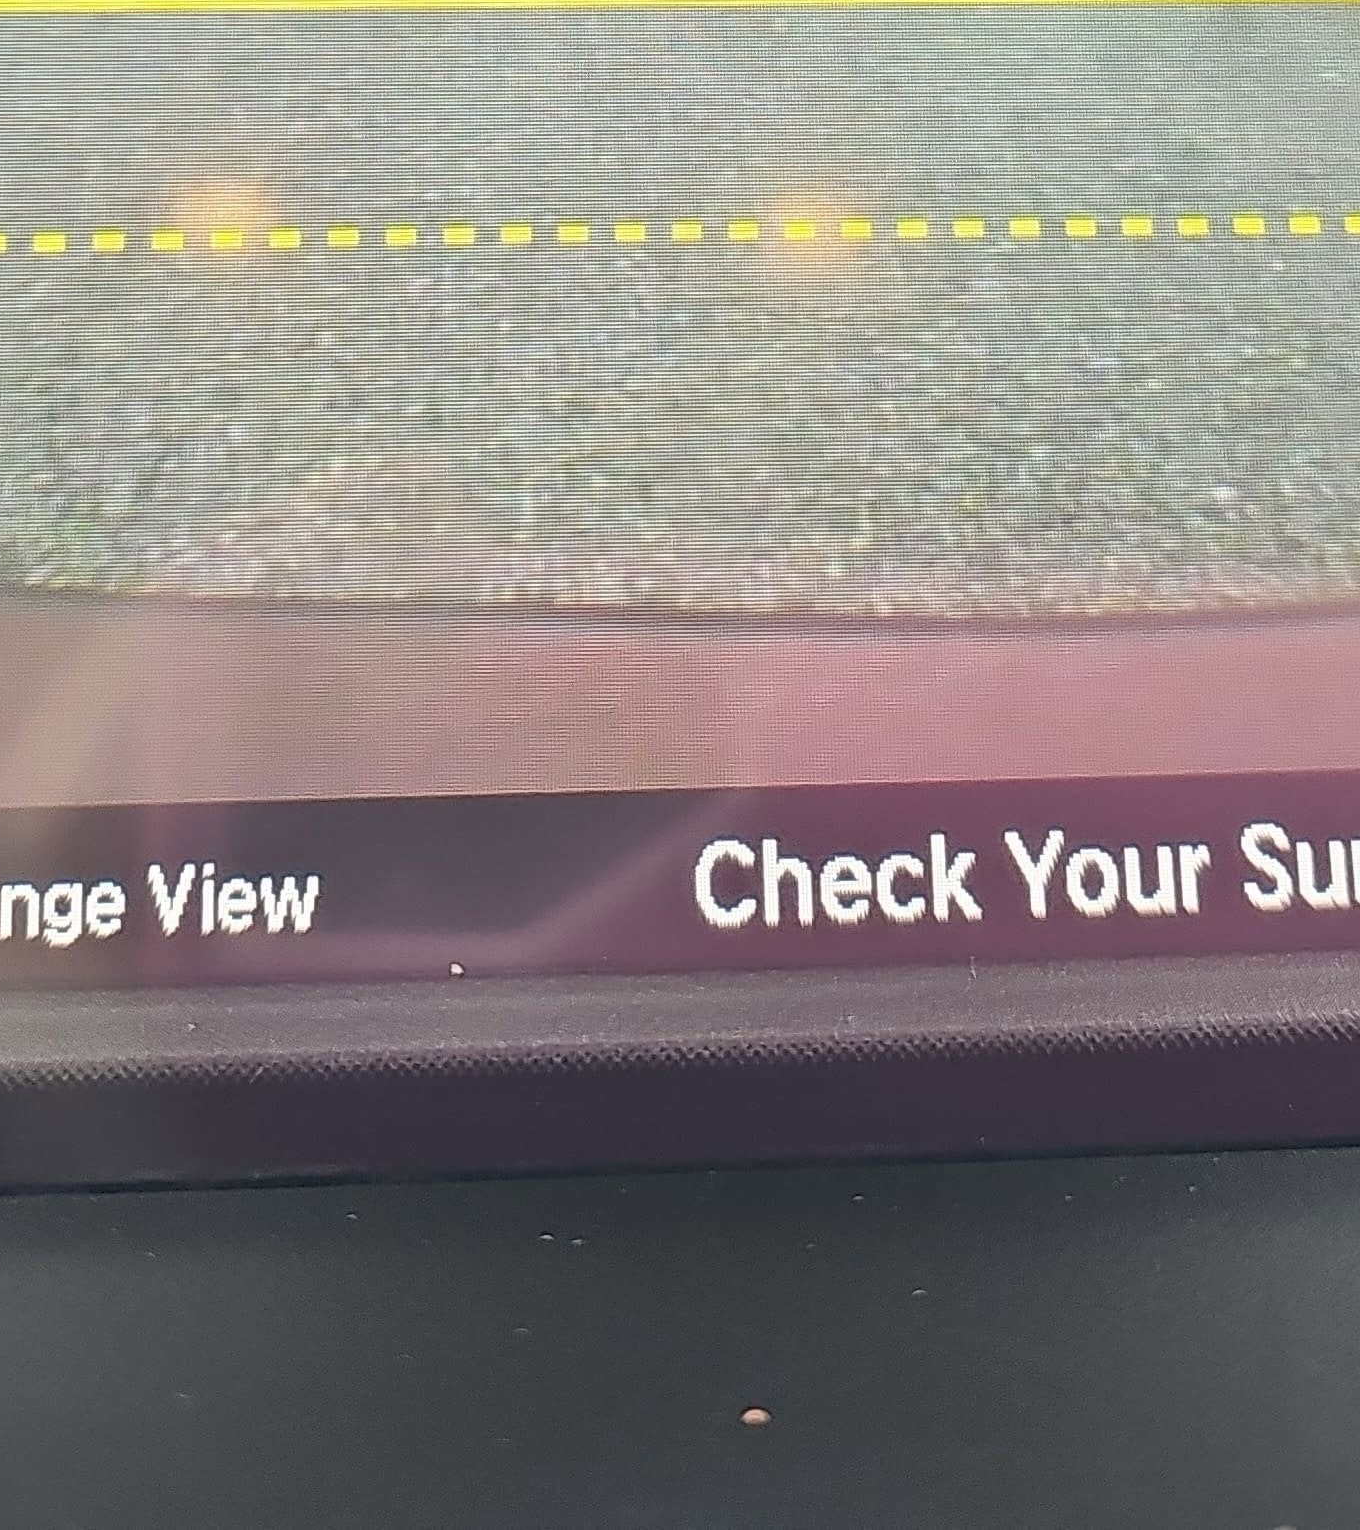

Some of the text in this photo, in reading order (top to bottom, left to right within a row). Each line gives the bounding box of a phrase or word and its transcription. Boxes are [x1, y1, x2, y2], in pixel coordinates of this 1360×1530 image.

[147, 861, 320, 936] View
[693, 832, 983, 929] Check
[1002, 828, 1211, 919] Your
